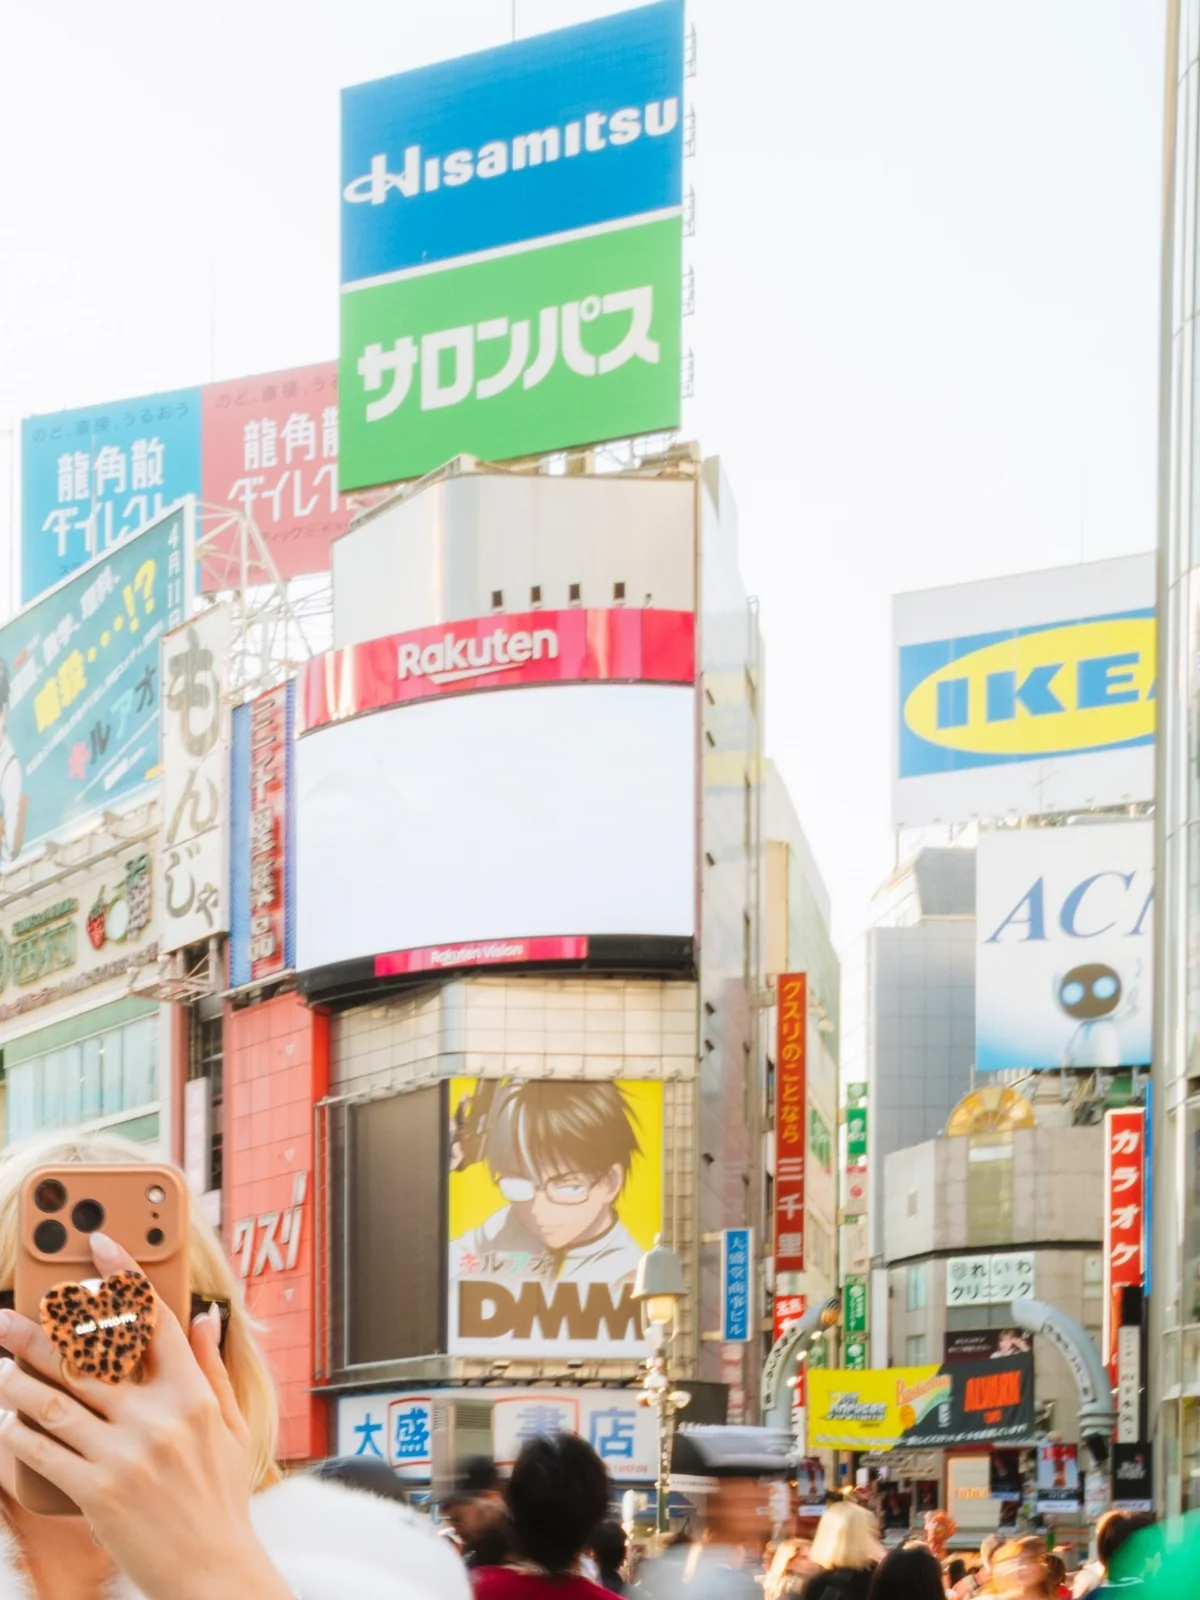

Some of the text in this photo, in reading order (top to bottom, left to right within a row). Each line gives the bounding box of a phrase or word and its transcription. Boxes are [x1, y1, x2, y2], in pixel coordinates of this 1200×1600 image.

[343, 97, 679, 205] Hisamitsu
[357, 285, 660, 423] サロンパス
[56, 436, 166, 503] 龍角散
[397, 627, 558, 685] Rakuten
[935, 651, 1156, 731] IKE
[430, 943, 524, 968] Rakuten Vision
[777, 979, 804, 1258] クスリのことなら 三千里
[1110, 1127, 1143, 1290] カラオケ
[459, 1251, 554, 1276] キルアオ
[951, 1281, 1032, 1301] クリニック
[971, 1259, 1033, 1279] れいわ
[354, 1409, 432, 1458] 大盛
